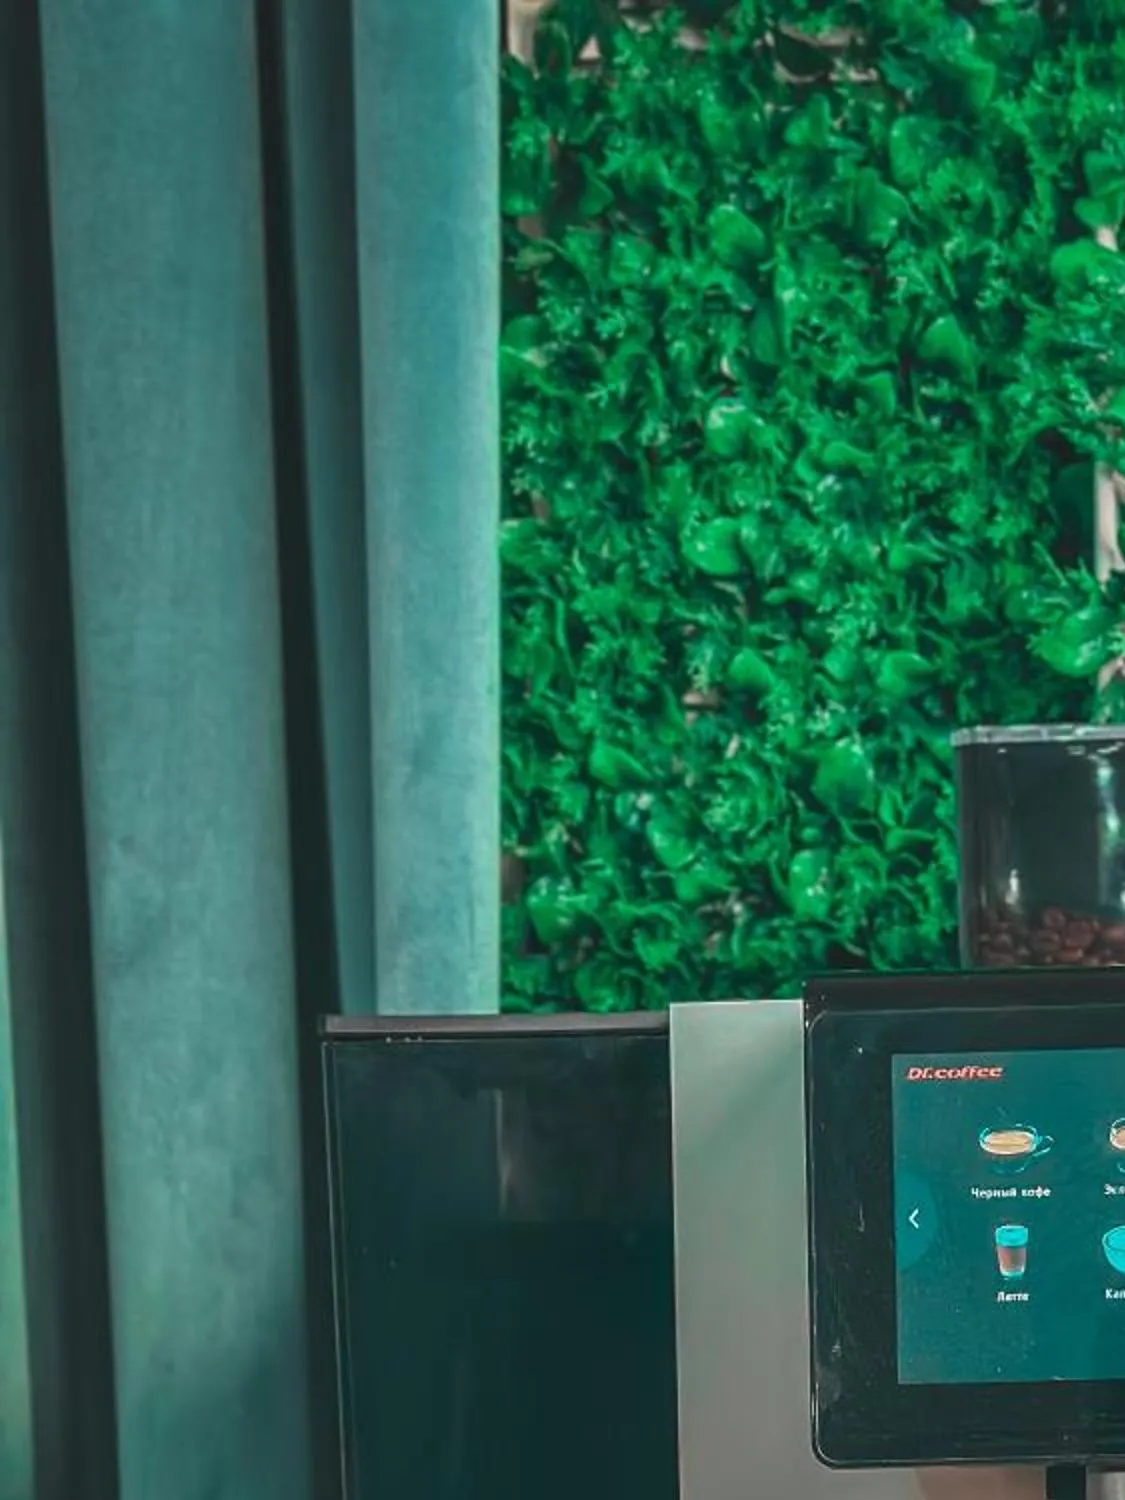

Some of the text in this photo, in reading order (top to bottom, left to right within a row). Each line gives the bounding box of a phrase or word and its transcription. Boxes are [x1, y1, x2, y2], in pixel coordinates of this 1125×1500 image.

[906, 1065, 1003, 1080] Dr.coffee
[1021, 1185, 1051, 1199] кофе
[996, 1290, 1030, 1303] Латте
